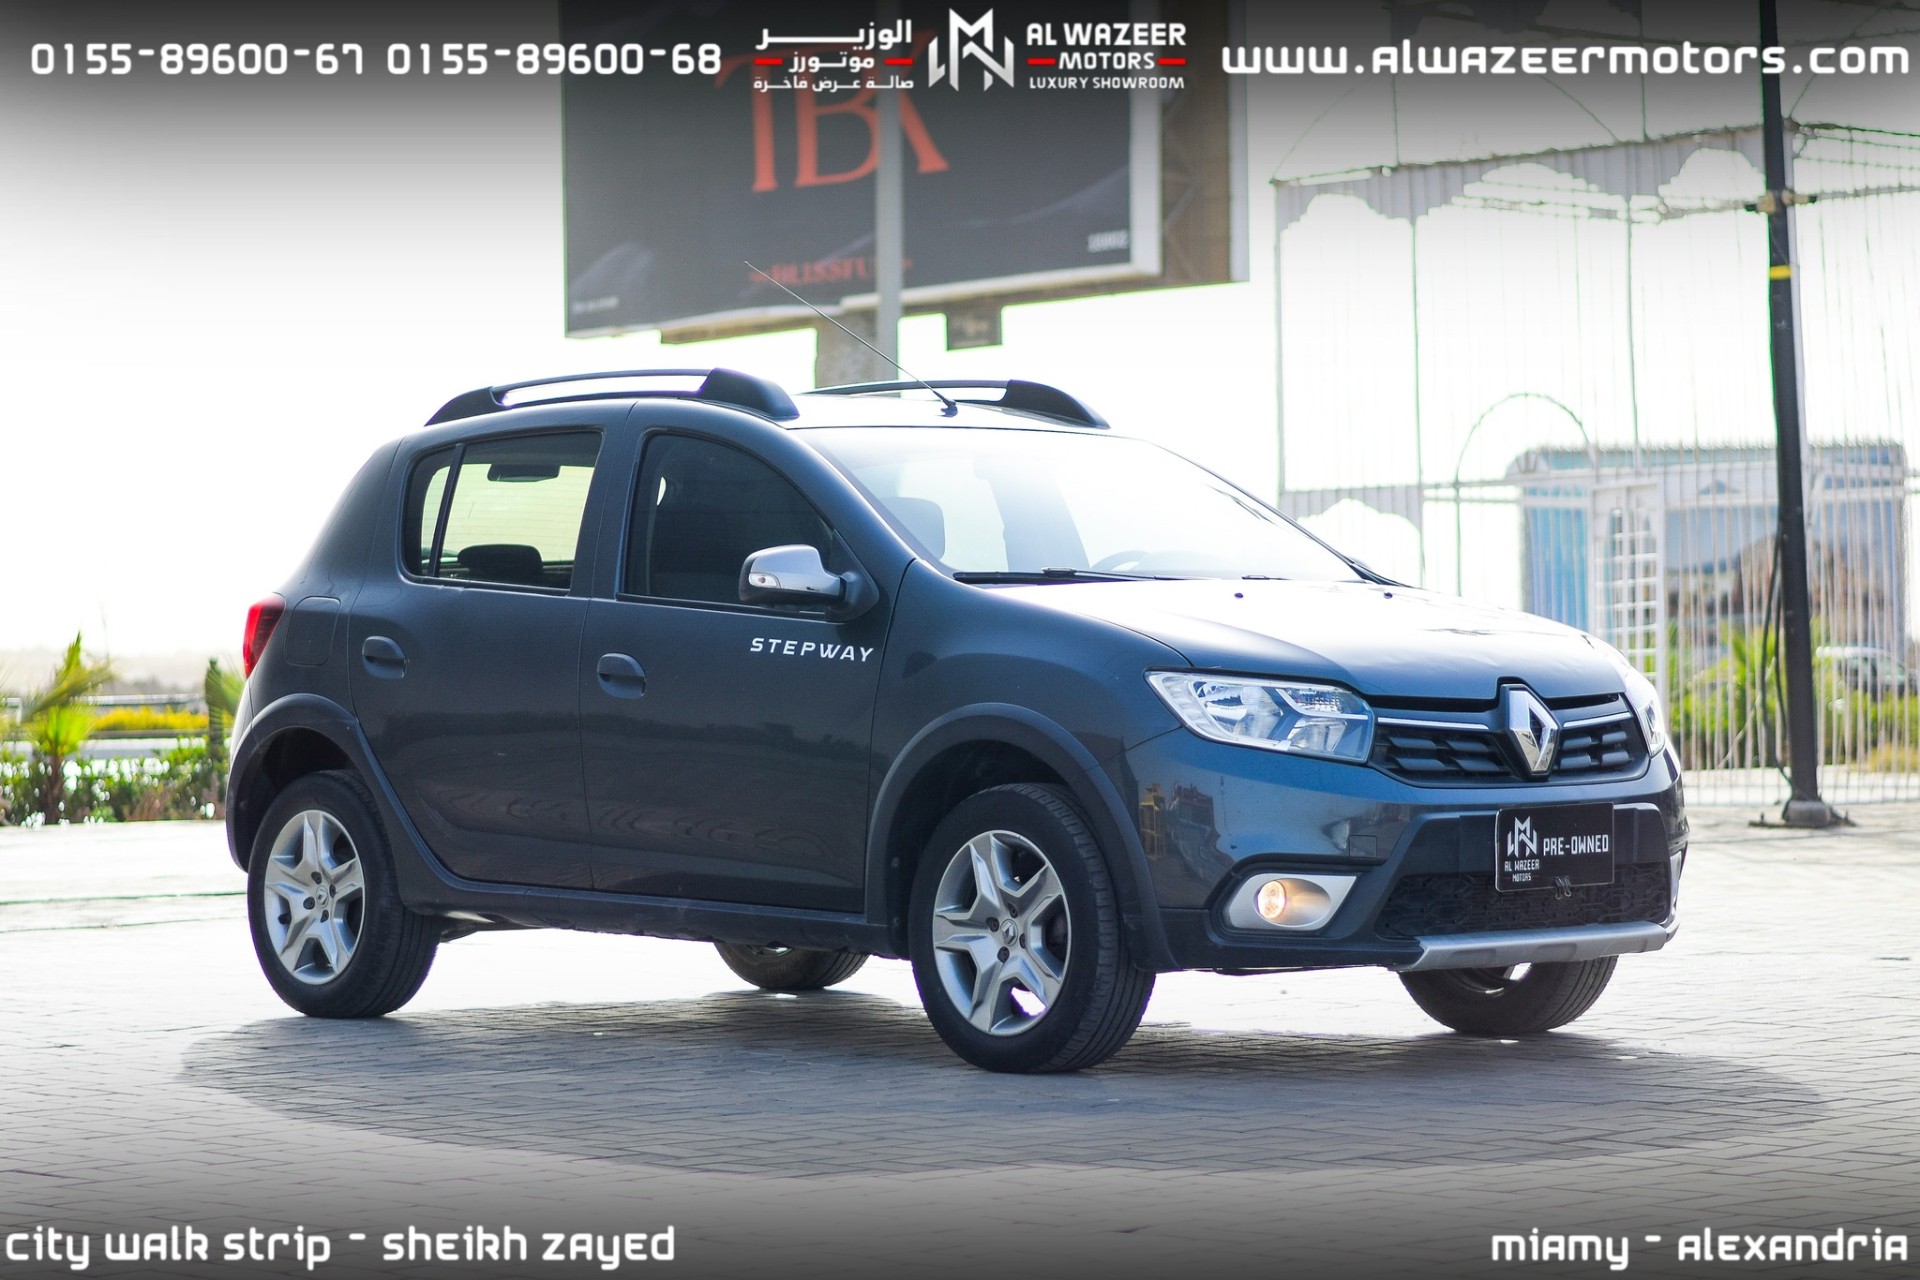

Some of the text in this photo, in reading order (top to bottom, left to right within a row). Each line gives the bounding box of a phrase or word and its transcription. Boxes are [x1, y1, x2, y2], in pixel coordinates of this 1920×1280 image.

[750, 637, 874, 662] STEPWAY
[1543, 834, 1609, 857] PRE-OWNED
[1504, 859, 1540, 872] AL WAZEER
[1512, 873, 1532, 882] MOTORS
